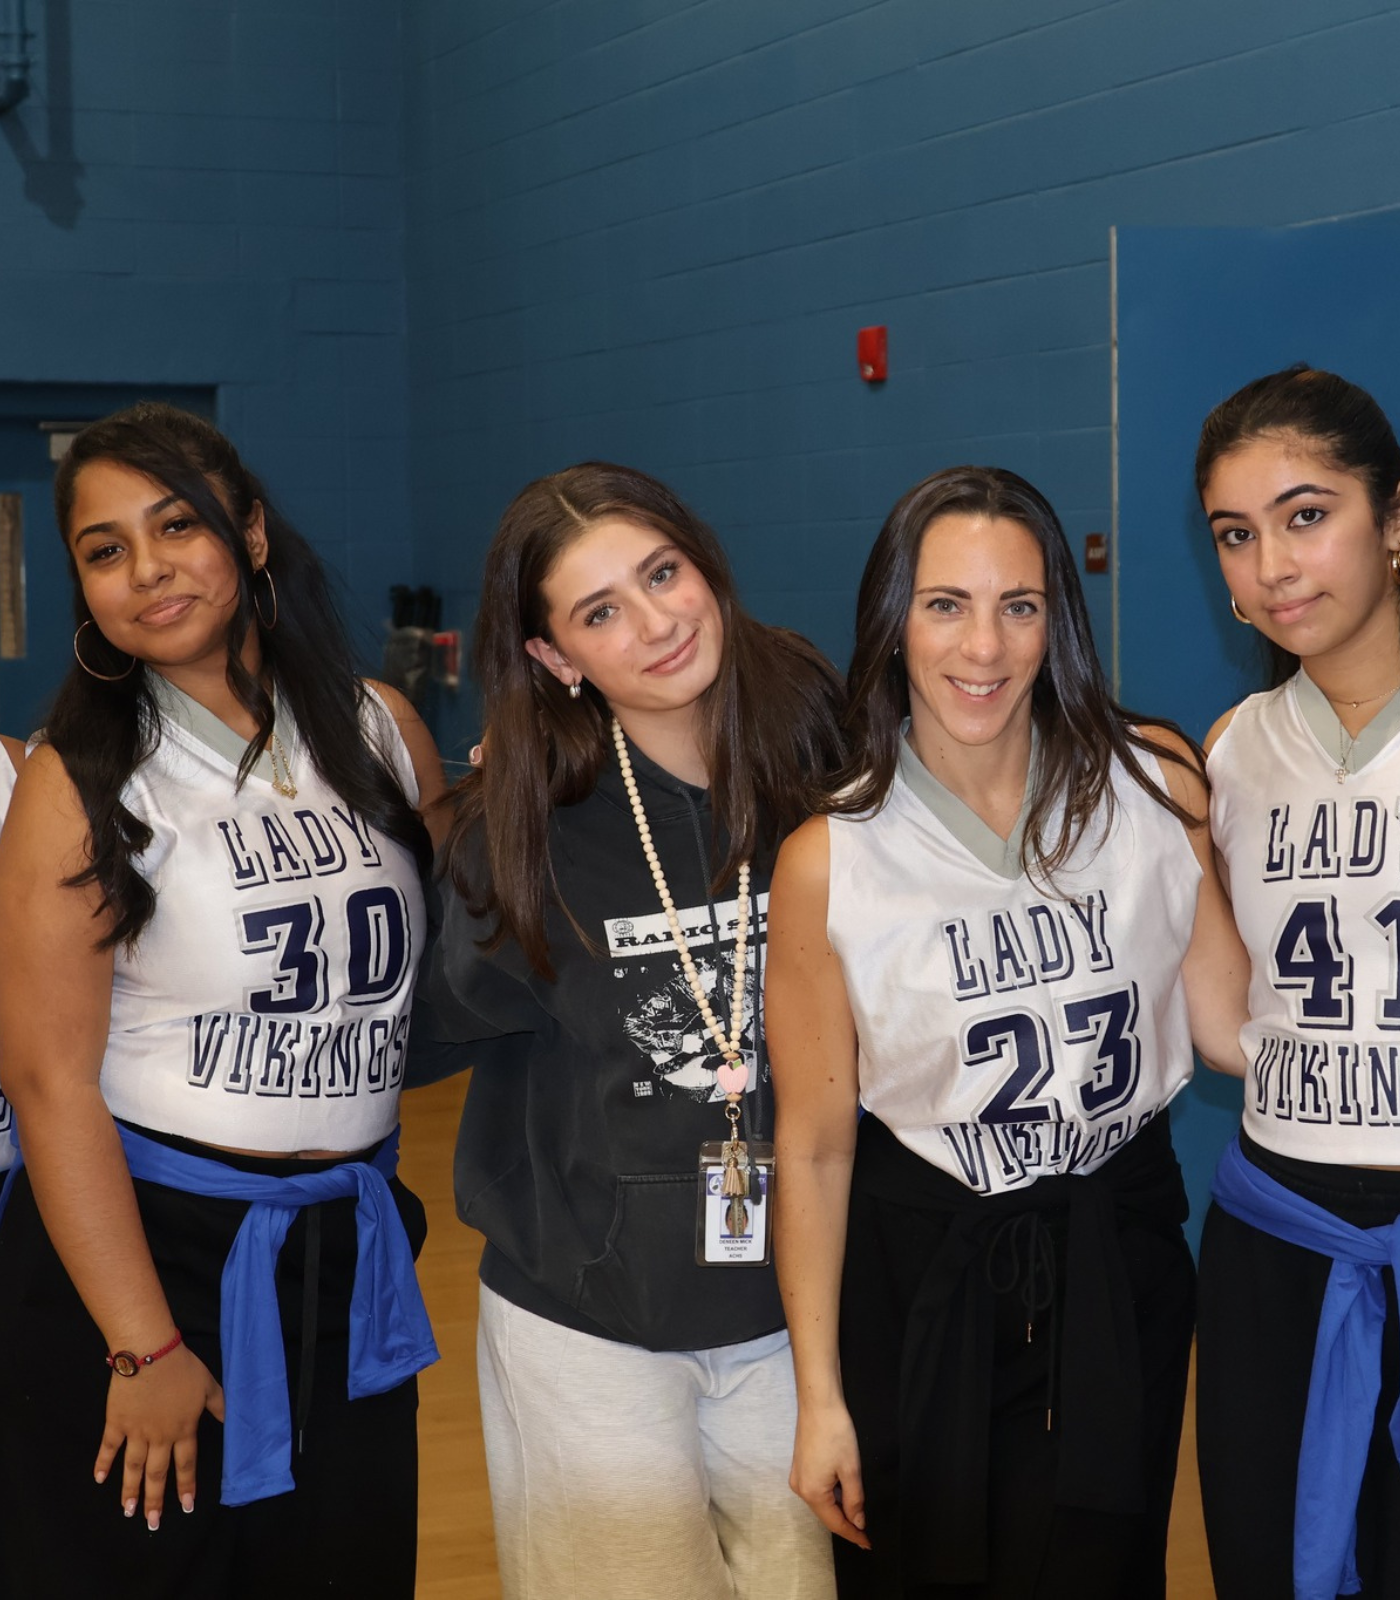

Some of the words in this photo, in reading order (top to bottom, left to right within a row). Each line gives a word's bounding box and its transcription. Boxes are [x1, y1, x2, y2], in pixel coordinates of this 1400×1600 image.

[214, 804, 382, 891] LADY
[1261, 797, 1400, 883] LAD
[234, 883, 411, 1015] 30
[940, 889, 1114, 1001] LADY
[187, 1011, 411, 1098] VIKINGS
[959, 980, 1142, 1124] 23
